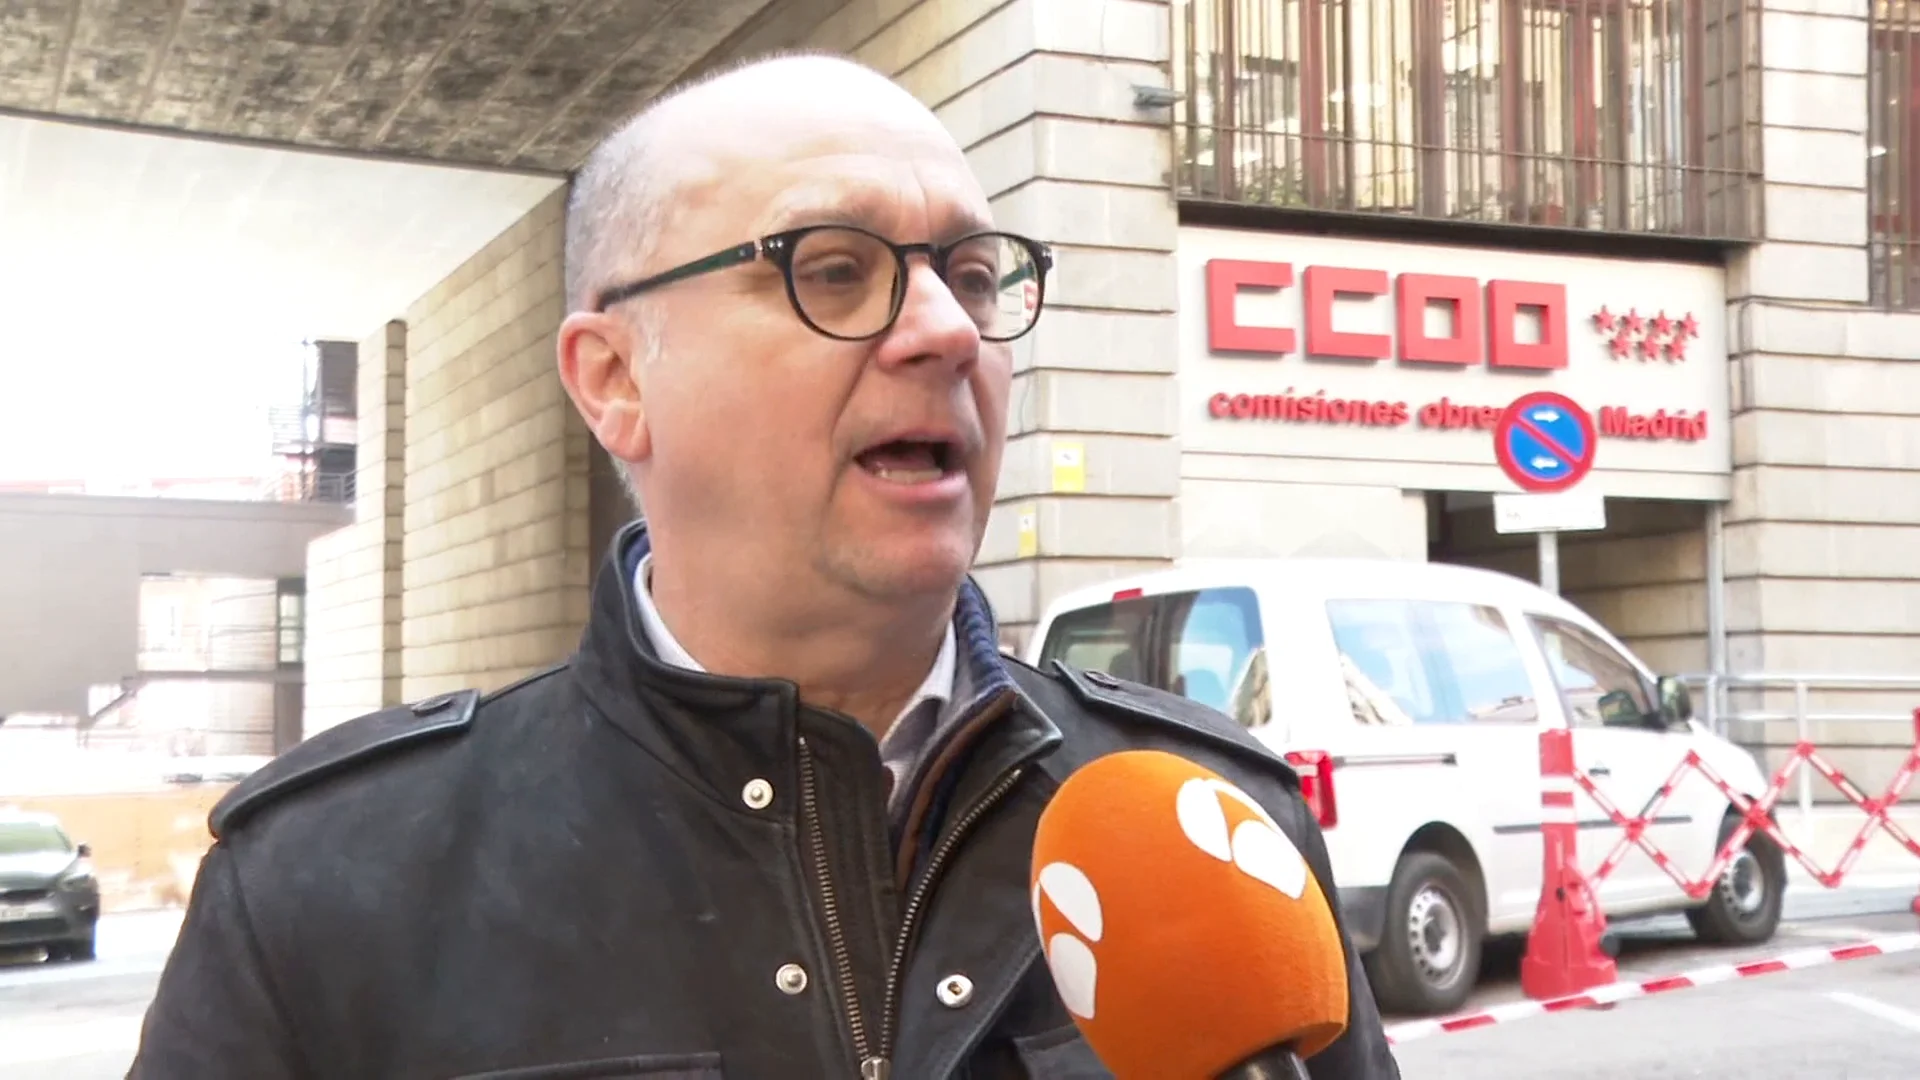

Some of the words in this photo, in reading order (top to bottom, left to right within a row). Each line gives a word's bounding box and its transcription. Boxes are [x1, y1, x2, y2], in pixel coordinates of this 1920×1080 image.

[1206, 258, 1568, 369] CCOO
[1208, 386, 1409, 427] comisiones
[1599, 405, 1708, 440] Madrid
